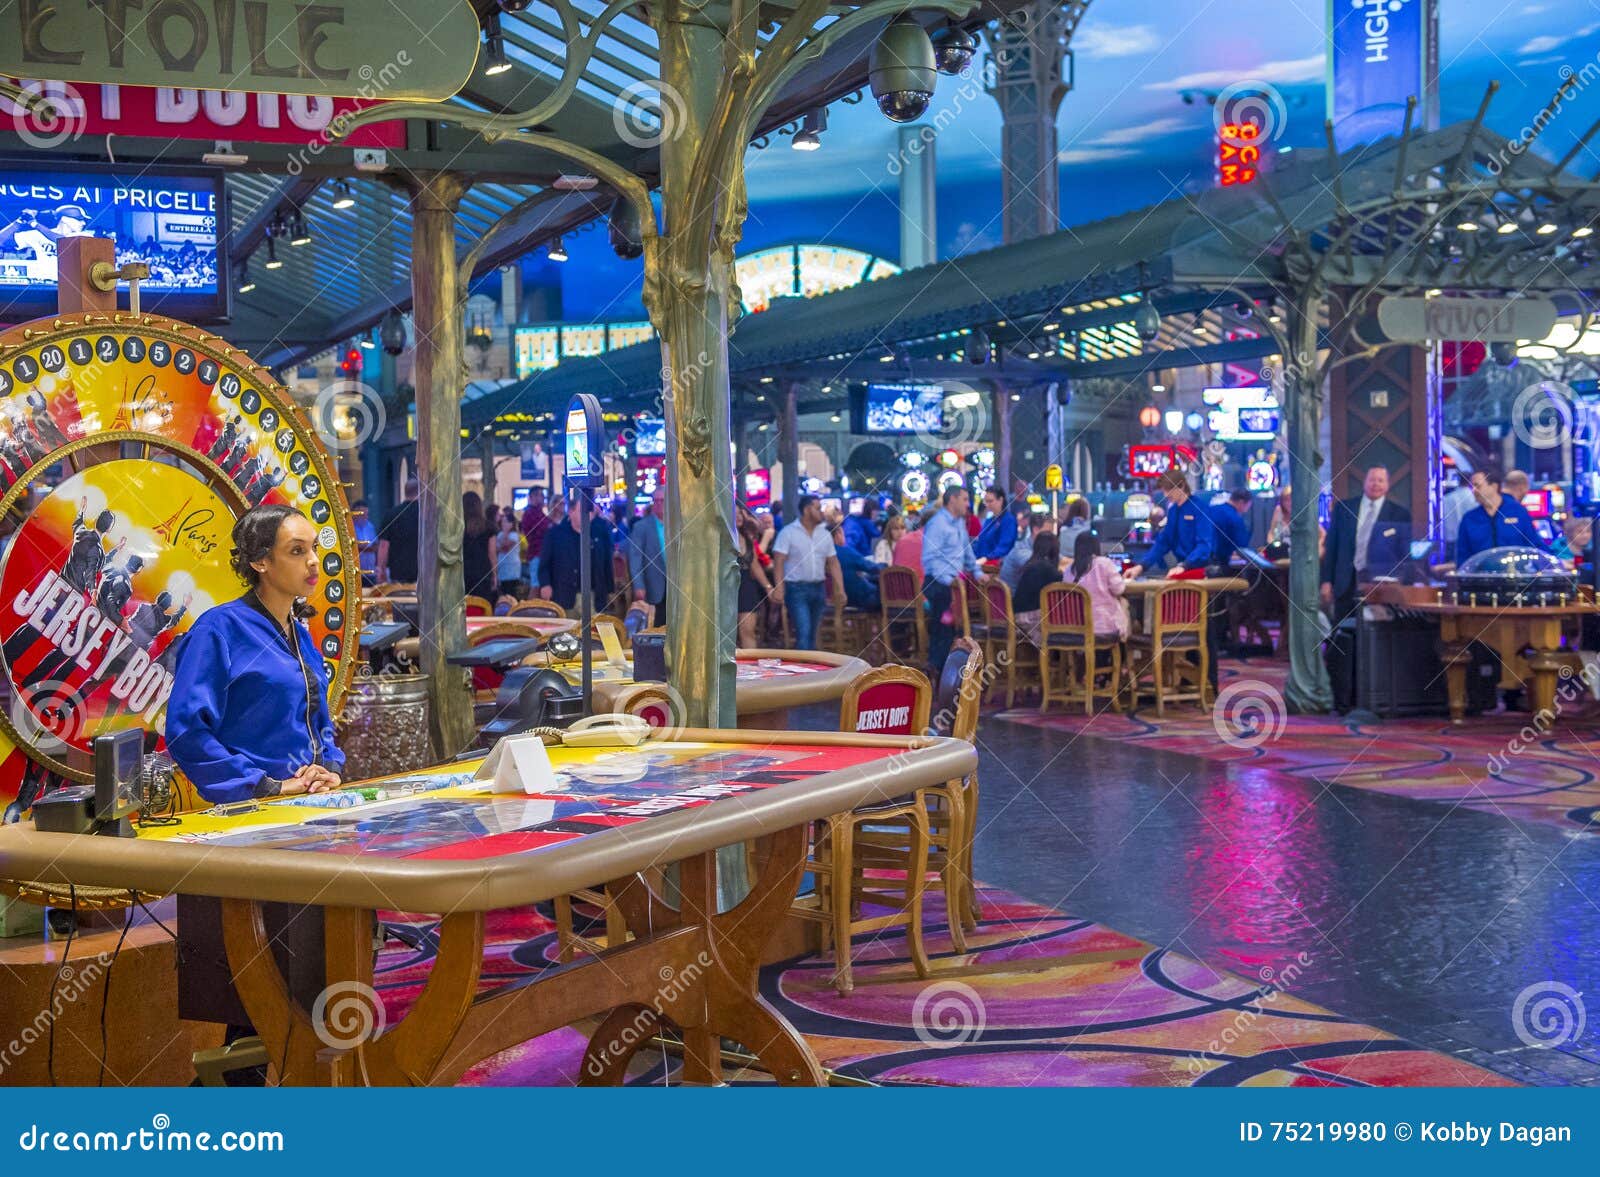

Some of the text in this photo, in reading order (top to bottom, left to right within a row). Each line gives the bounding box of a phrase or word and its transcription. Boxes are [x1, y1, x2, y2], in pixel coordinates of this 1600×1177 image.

[1364, 0, 1389, 62] HIGH
[77, 343, 86, 359] 1
[102, 341, 113, 357] 2
[130, 342, 139, 358] 1
[154, 346, 164, 362] 5
[42, 349, 62, 369] 20
[179, 354, 191, 370] 2
[20, 360, 32, 377] 1
[203, 365, 213, 381] 1
[221, 376, 239, 396] 10
[244, 395, 255, 410] 1
[294, 456, 305, 470] 1
[173, 508, 218, 553] Paris
[329, 586, 341, 598] 2
[12, 569, 133, 681] JERSEY
[328, 614, 340, 623] 1
[325, 640, 338, 652] 5
[856, 706, 910, 731] JERSEY BOYS
